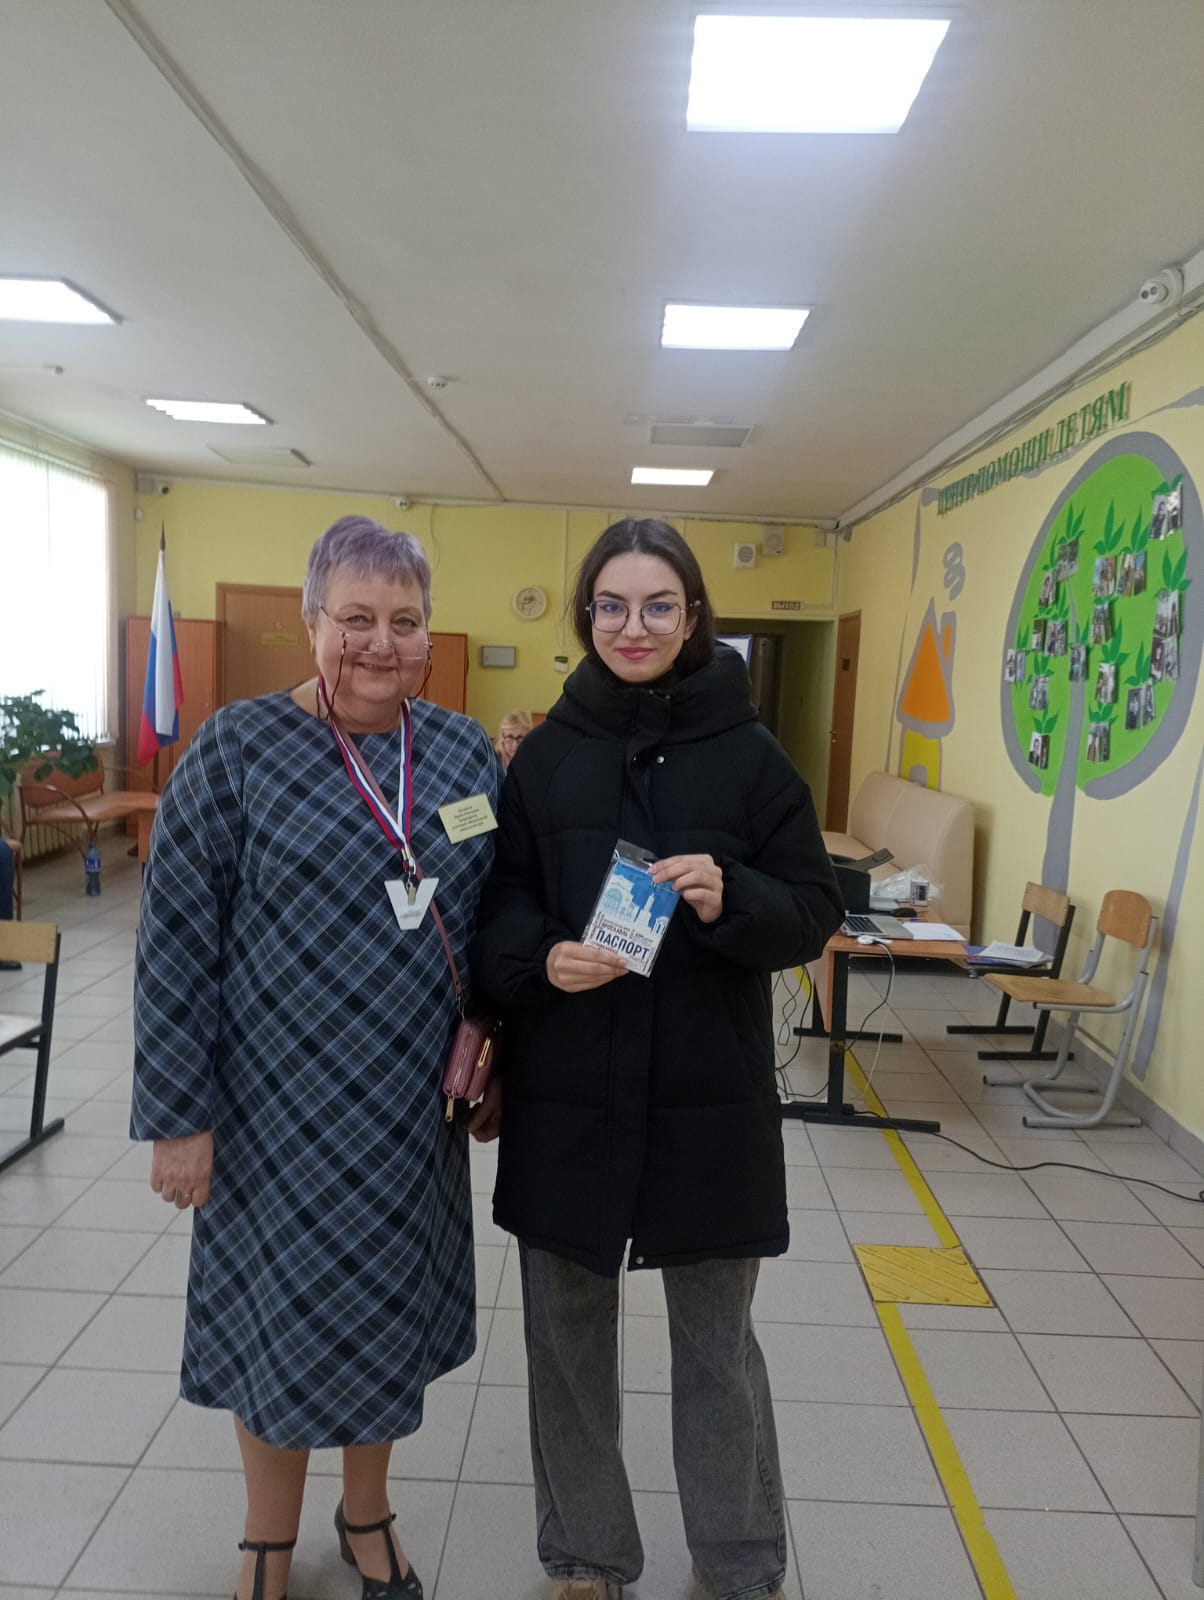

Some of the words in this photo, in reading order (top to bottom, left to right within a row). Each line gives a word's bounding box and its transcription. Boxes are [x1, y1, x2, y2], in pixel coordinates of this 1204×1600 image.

[937, 472, 977, 518] ЦЕНТР
[977, 428, 1049, 496] ПОМОЩИ
[1050, 381, 1128, 457] ДЕТЯМ
[772, 601, 800, 610] ВЫХОД
[596, 930, 649, 960] ПАСПОРТ
